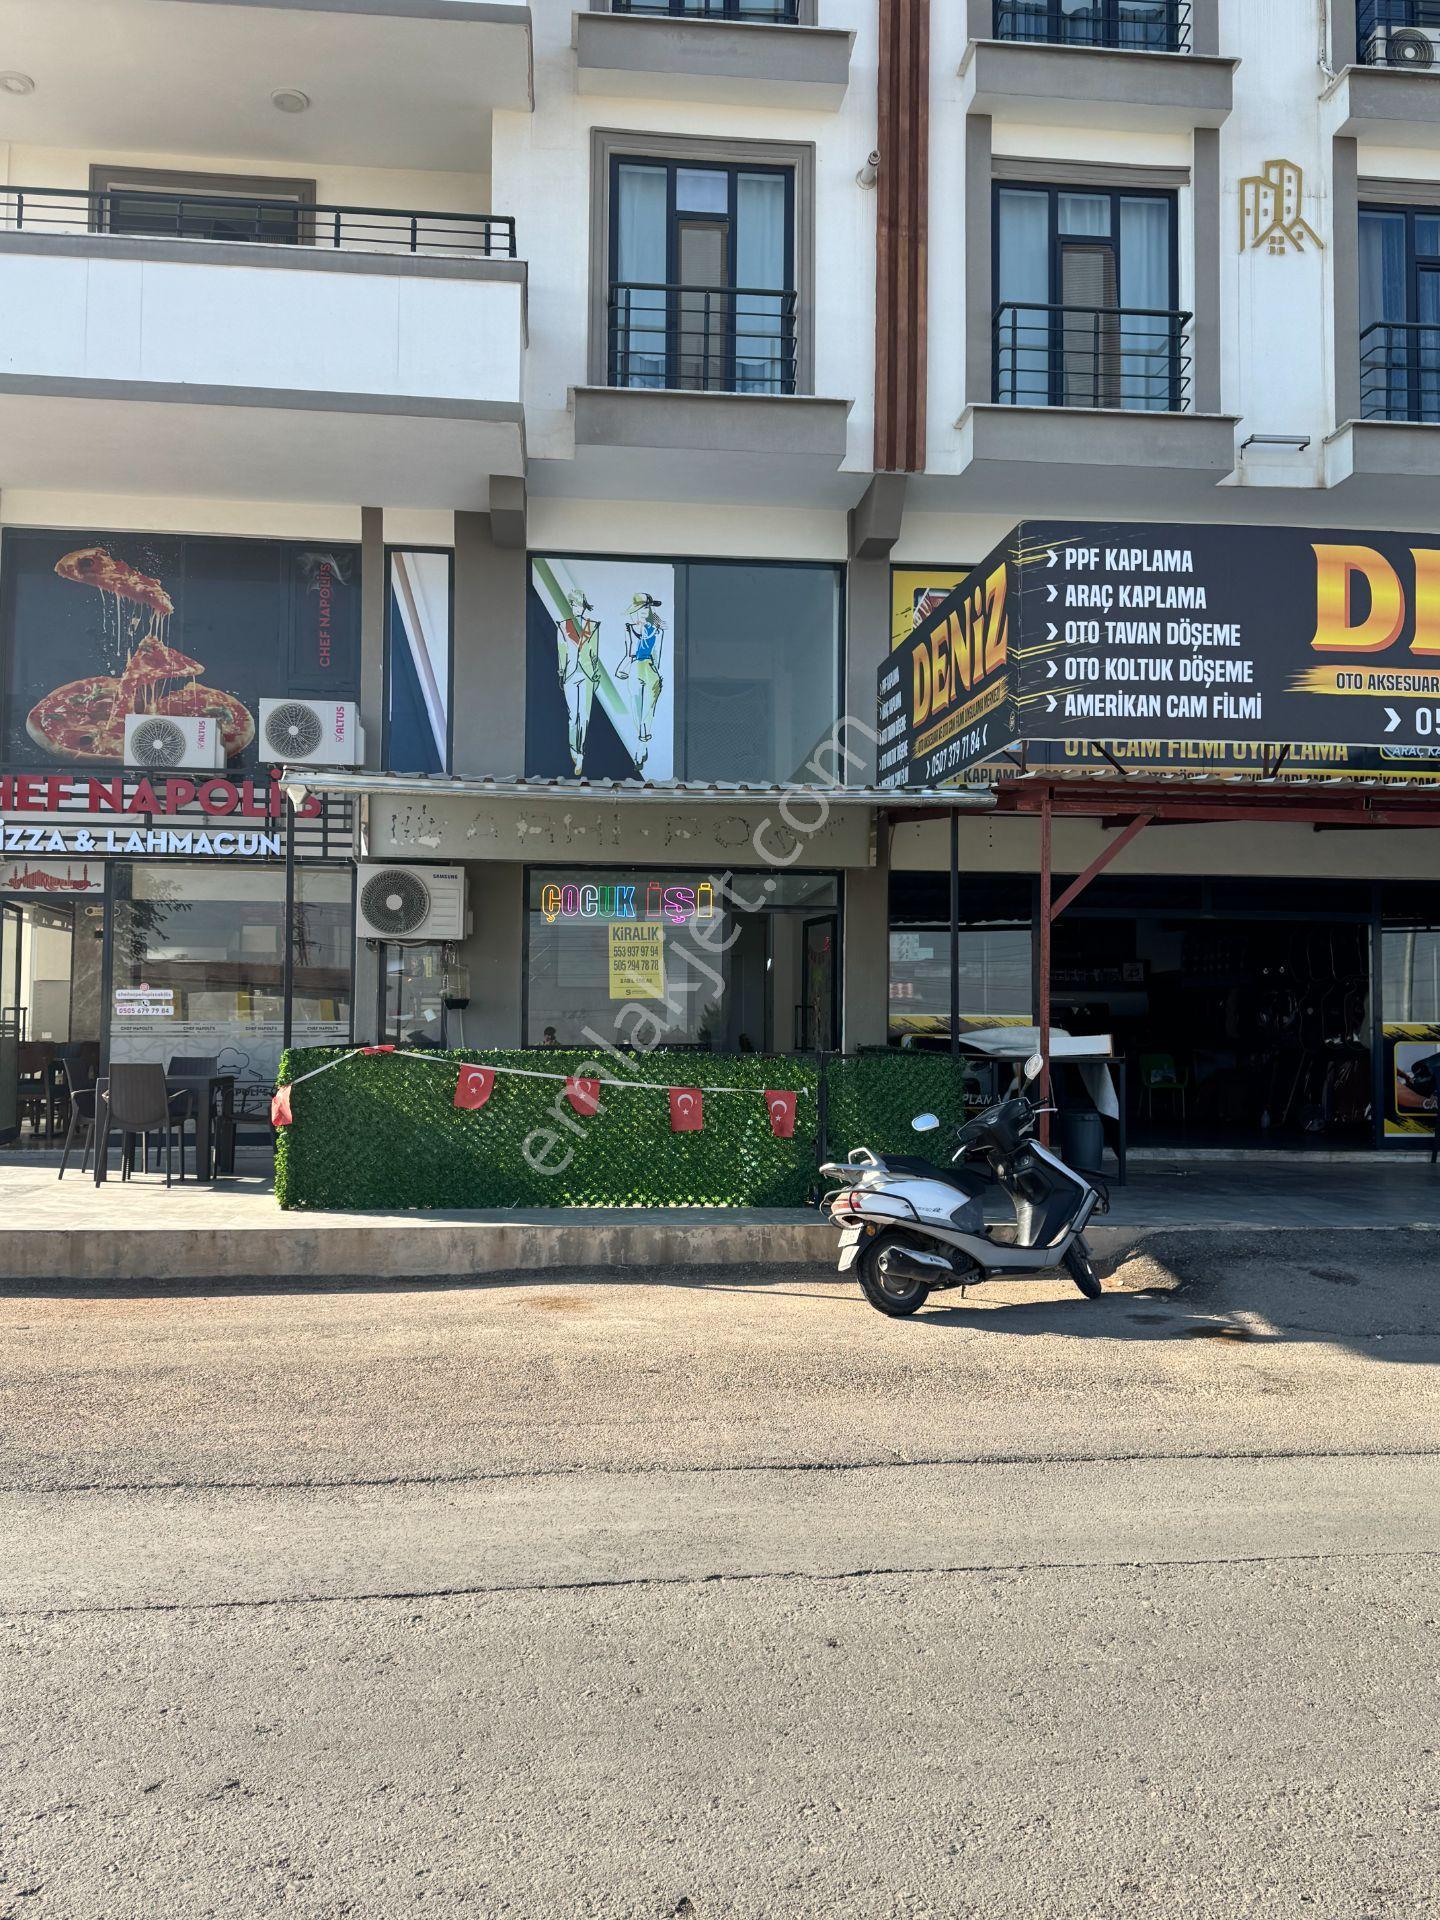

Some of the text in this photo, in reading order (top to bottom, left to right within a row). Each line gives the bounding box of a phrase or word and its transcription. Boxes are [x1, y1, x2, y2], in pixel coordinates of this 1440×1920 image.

[1065, 548, 1193, 572] PPF KAPLAMA
[1065, 584, 1207, 614] ARAÇ KAPLAMA
[319, 630, 331, 668] CHEF
[1065, 618, 1240, 651] OTO TAVAN DÖŞEME
[1065, 655, 1253, 688] OTO KOLTUK DÖŞEME
[1336, 672, 1363, 690] OTO
[1064, 690, 1262, 719] AMERİKAN CAM FİLMİ
[335, 705, 345, 734] ALTUS
[74, 829, 95, 852] &
[107, 830, 281, 856] LAHMACUN
[542, 882, 713, 923] ÇOCUK İŞİ
[613, 946, 659, 957] 553 937 97 94
[613, 959, 626, 970] 505
